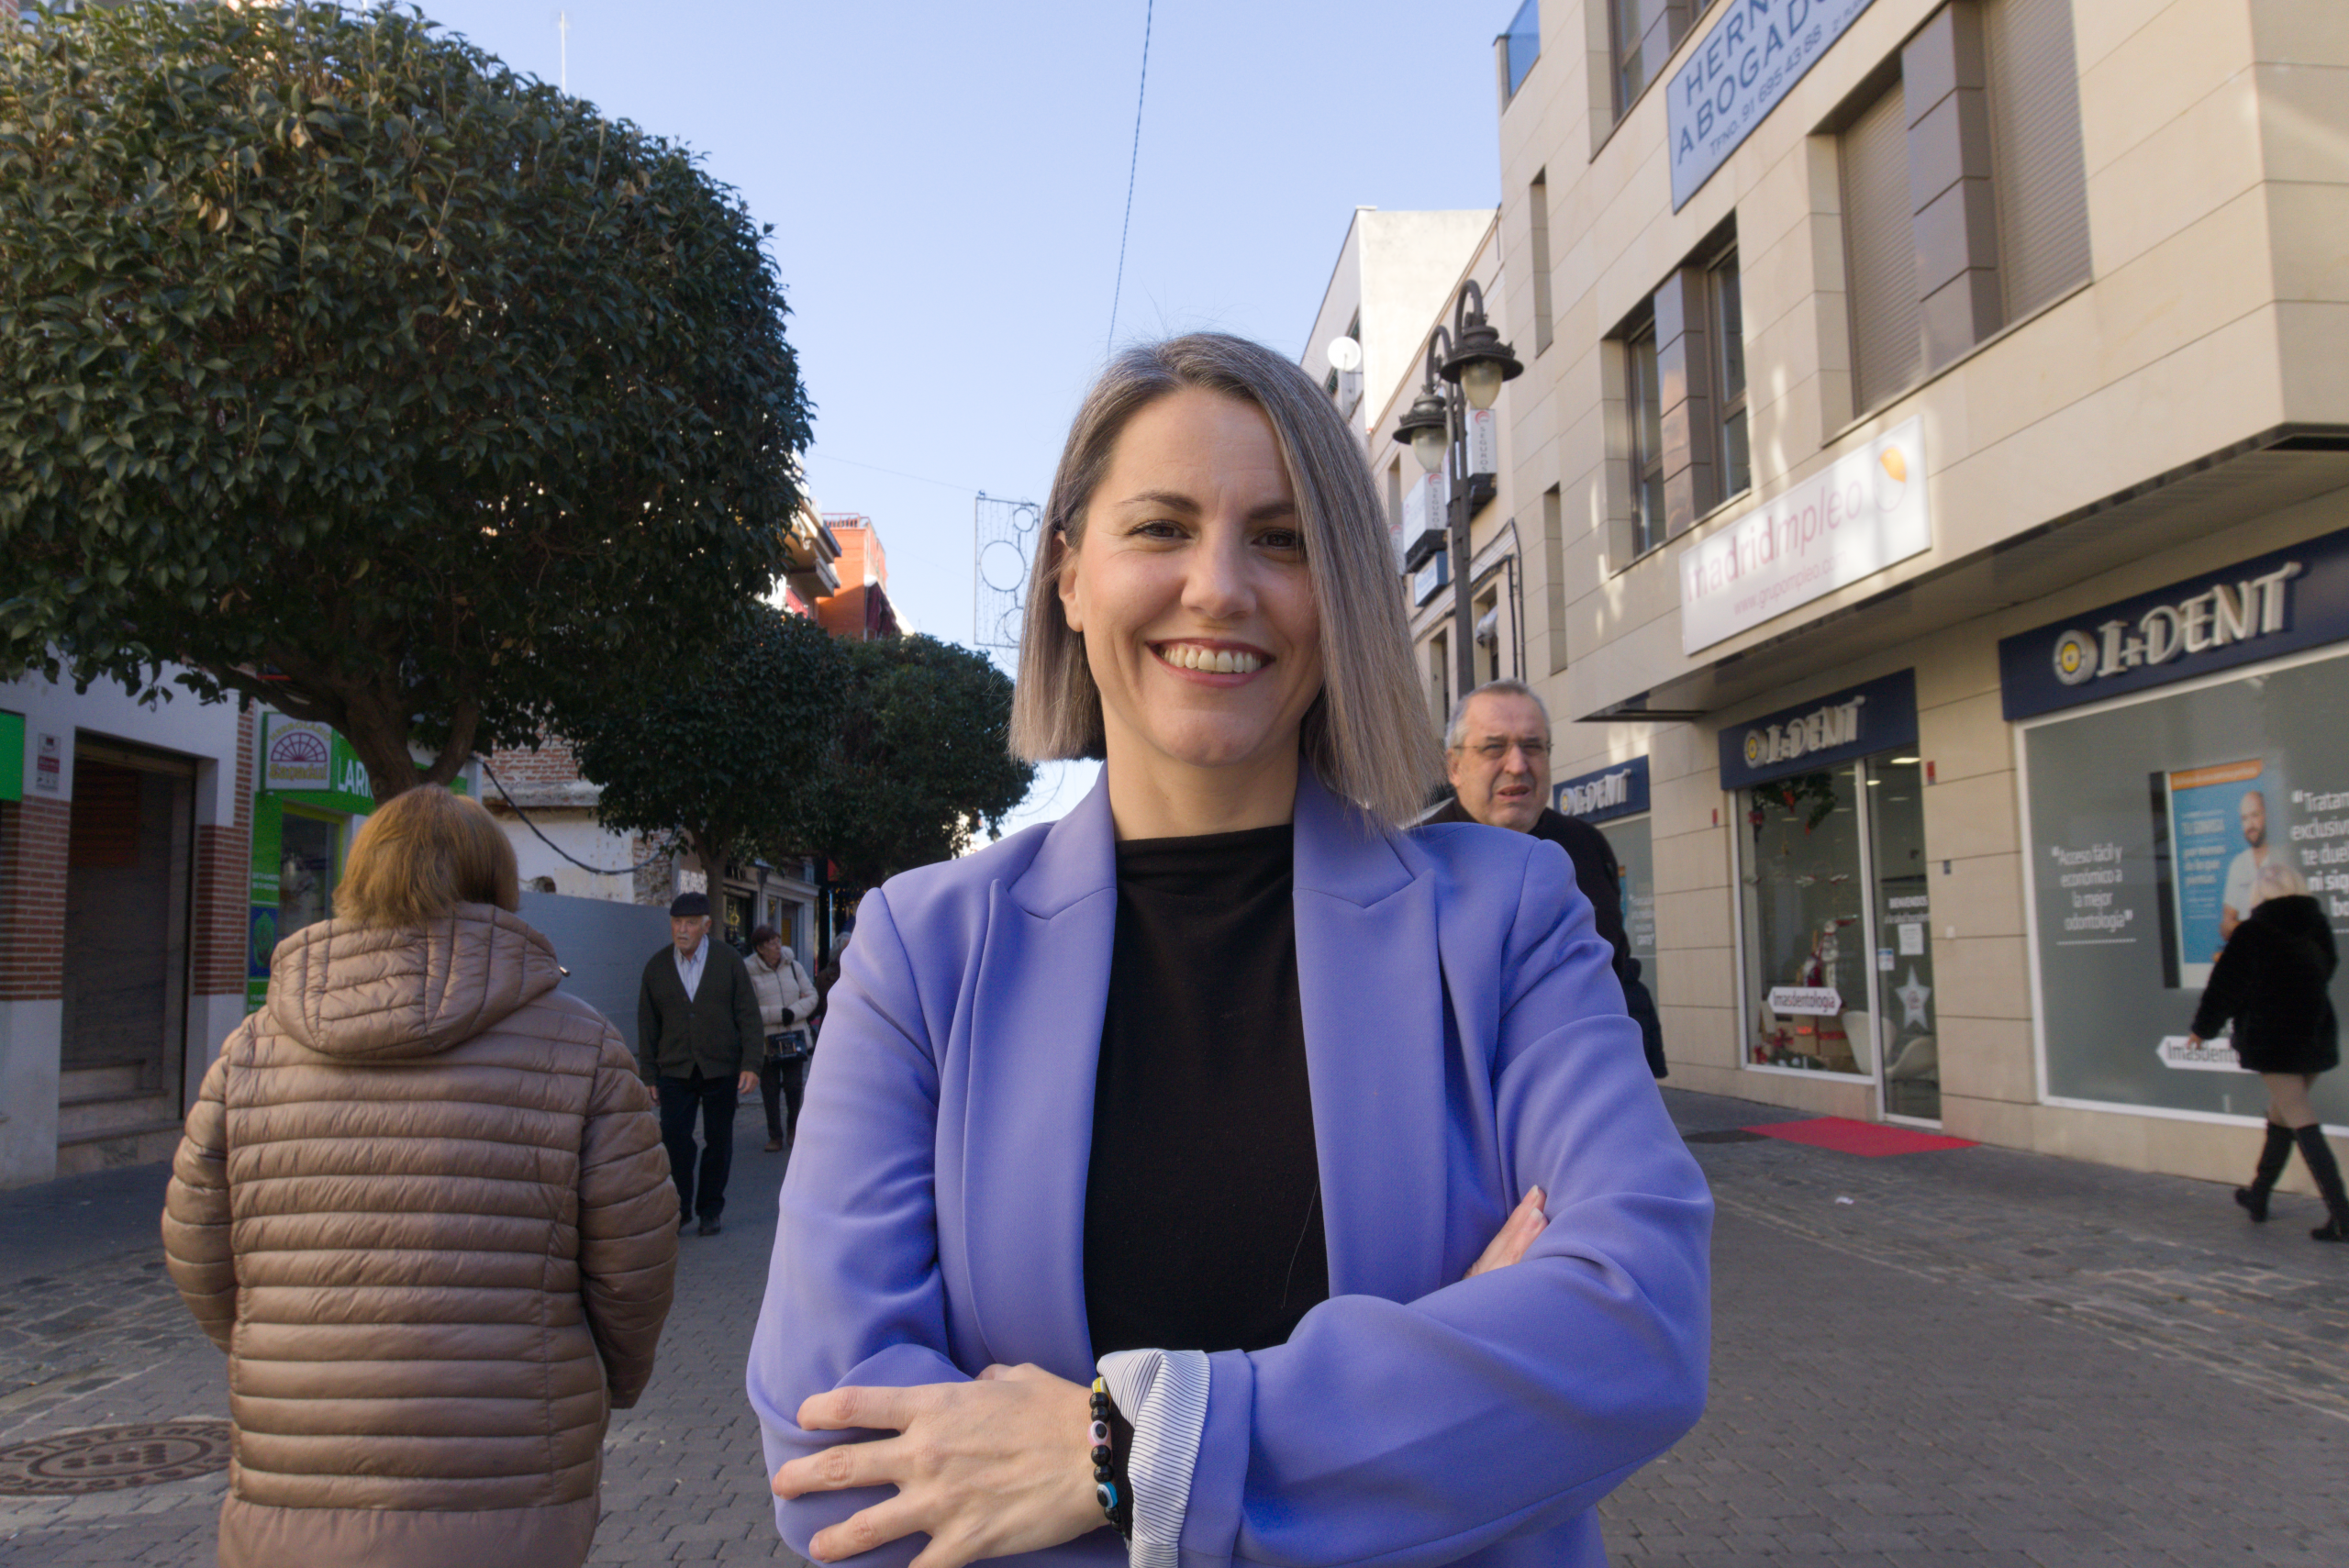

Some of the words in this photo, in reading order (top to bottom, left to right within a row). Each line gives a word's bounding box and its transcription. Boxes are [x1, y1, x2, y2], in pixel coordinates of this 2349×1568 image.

[1678, 0, 1826, 164] ABOGAD
[1686, 0, 1777, 107] HERN
[1742, 97, 1754, 123] 91
[1758, 67, 1784, 104] 695
[1785, 46, 1802, 74] 43
